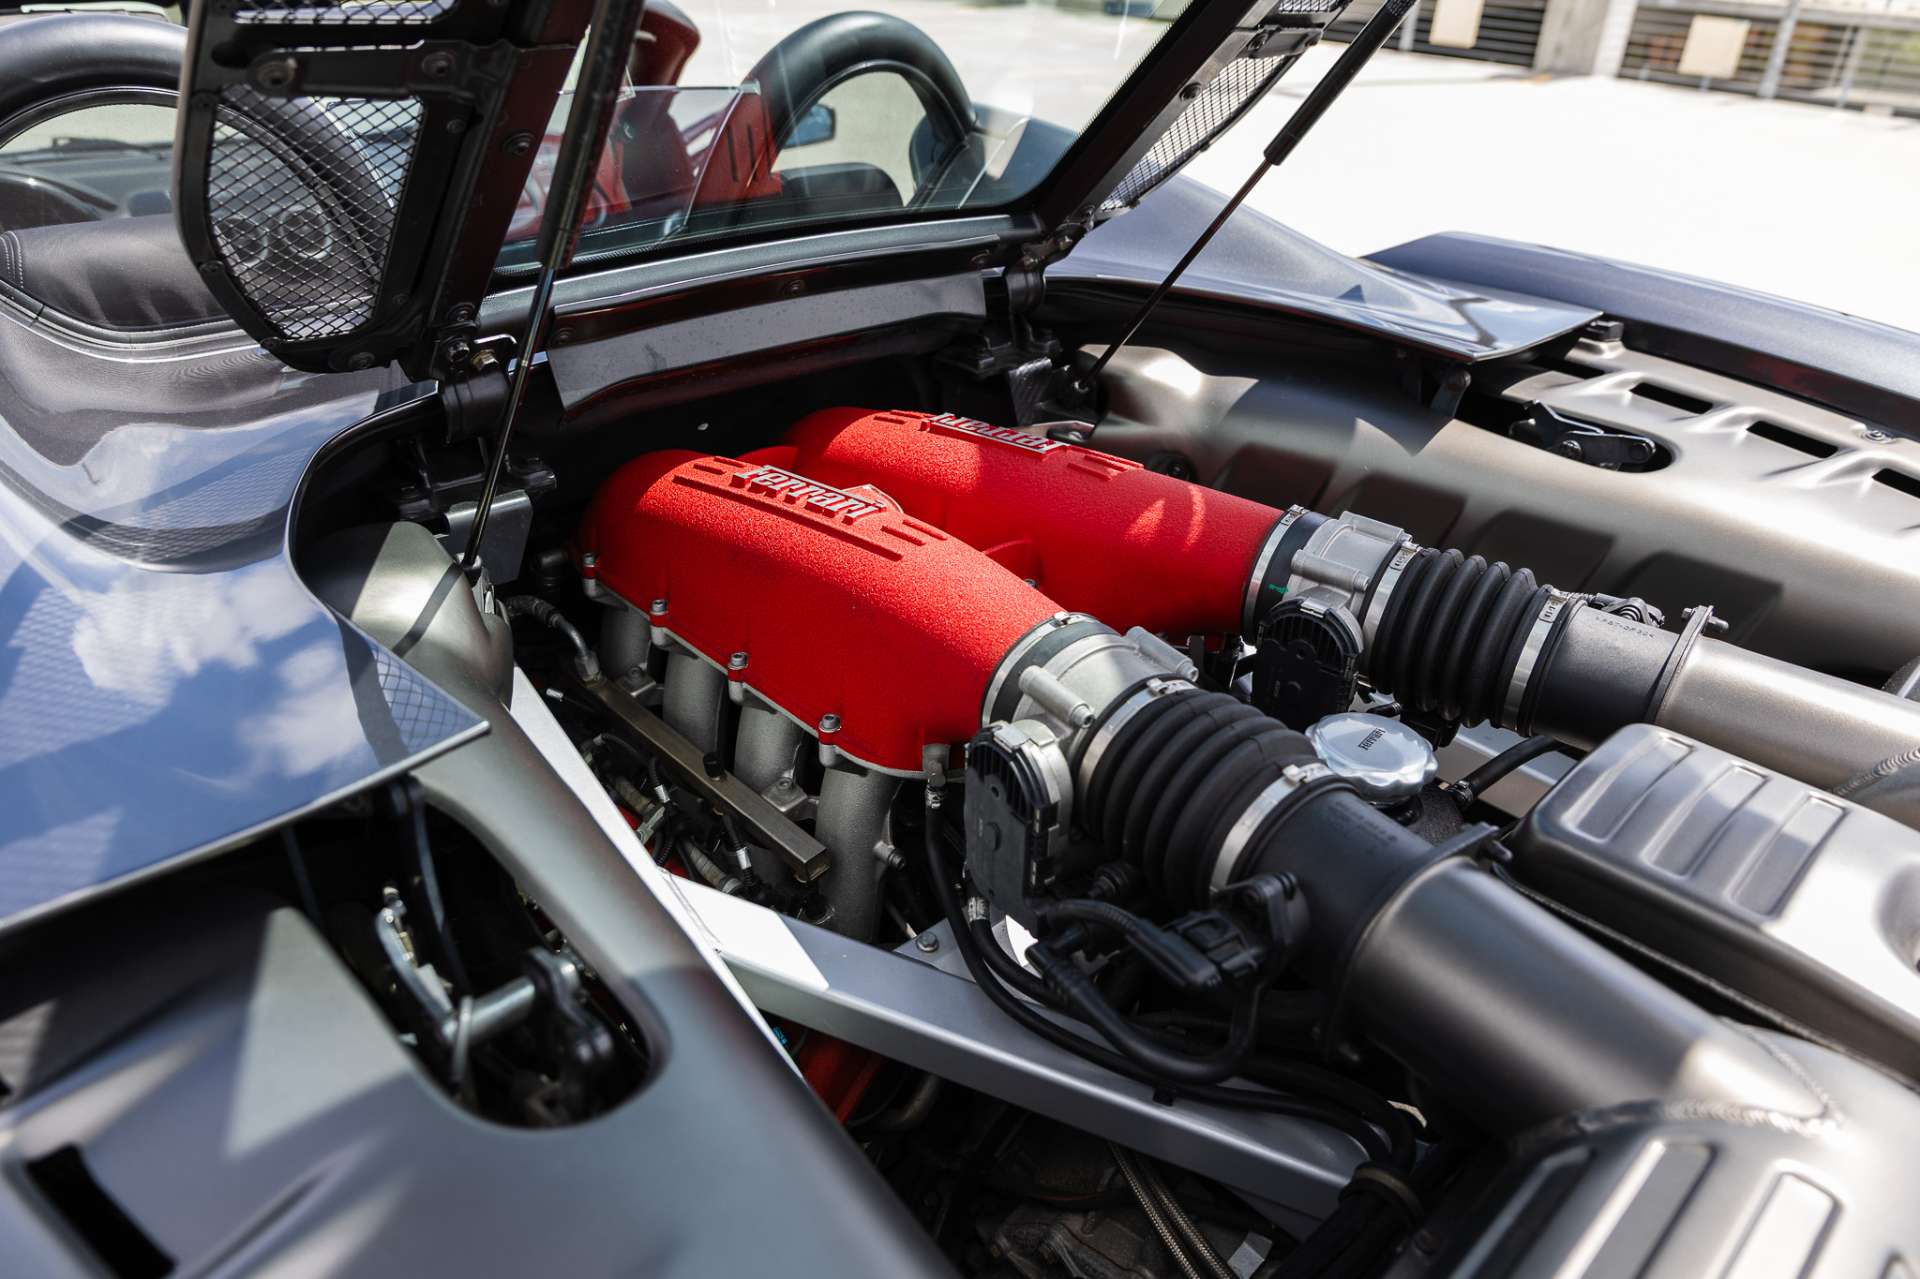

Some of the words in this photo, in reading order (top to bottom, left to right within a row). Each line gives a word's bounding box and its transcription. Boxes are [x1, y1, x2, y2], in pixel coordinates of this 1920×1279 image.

[928, 411, 1070, 454] Ferrari
[731, 465, 886, 522] Ferrari
[1358, 728, 1386, 751] Ferrari
